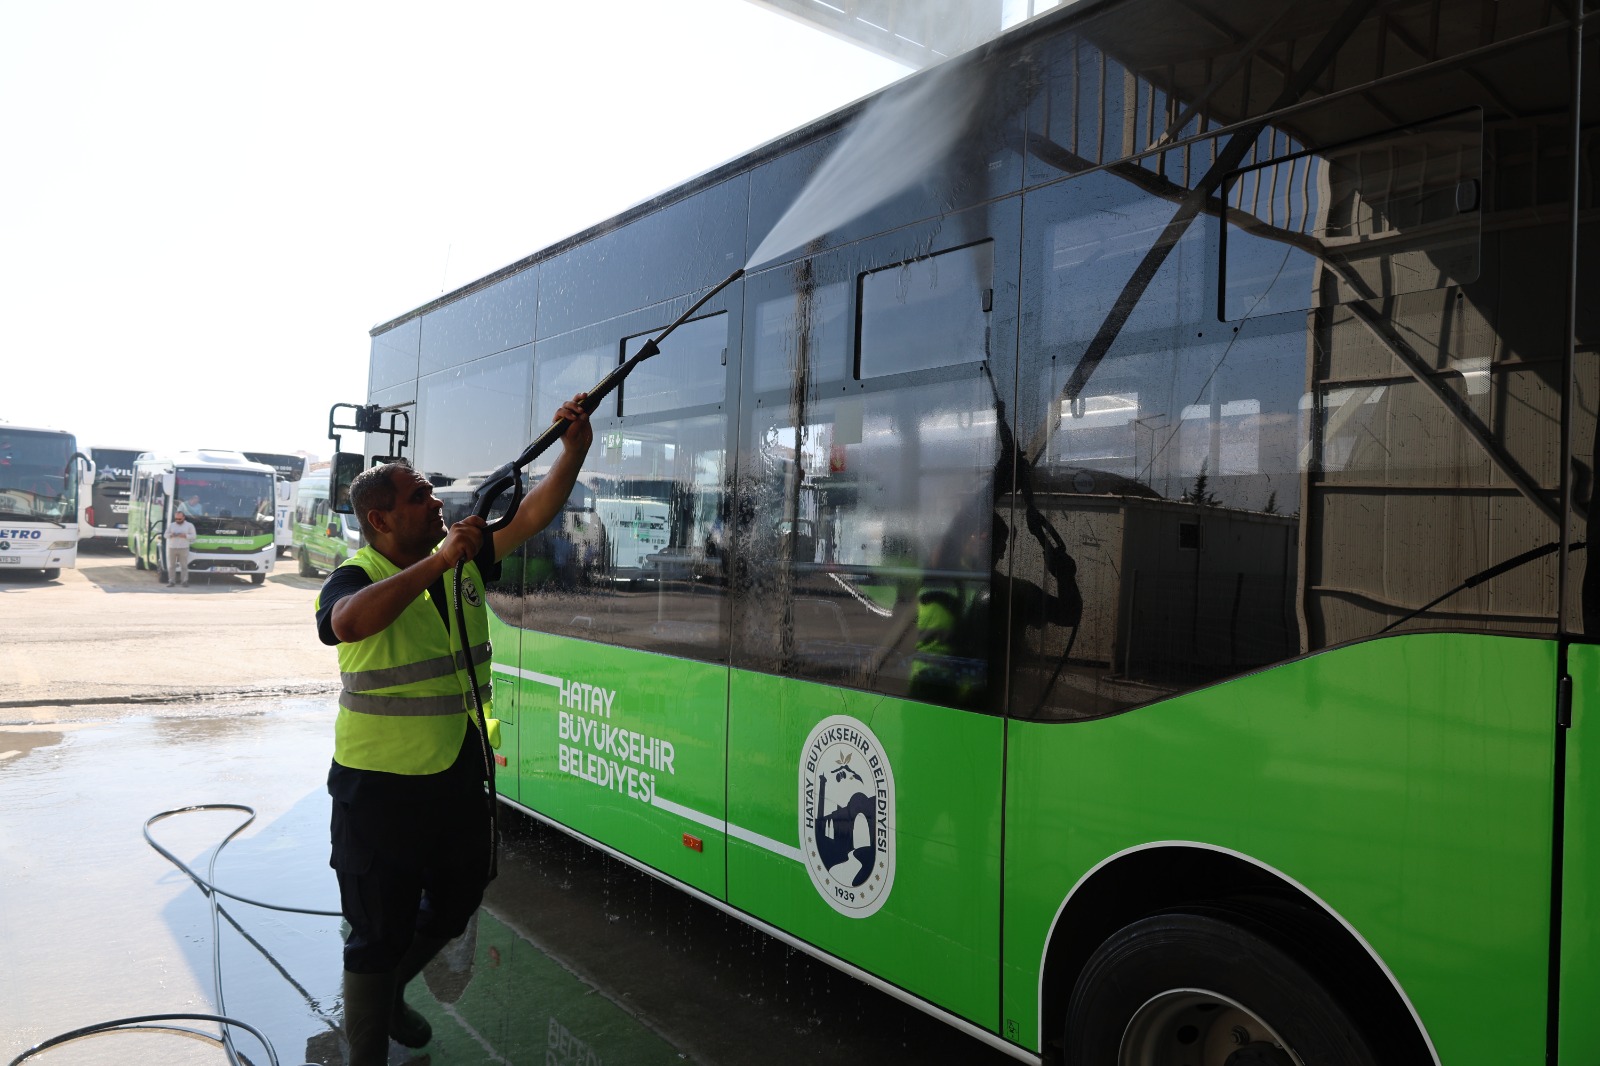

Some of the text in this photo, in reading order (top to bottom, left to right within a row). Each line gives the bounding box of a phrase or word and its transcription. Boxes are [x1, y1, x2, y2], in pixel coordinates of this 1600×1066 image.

[559, 678, 616, 718] HATAY
[558, 710, 676, 775] BÜYÜKŞEHİR
[558, 743, 657, 806] BELEDİYESİ
[805, 778, 815, 829] HATAY
[834, 886, 855, 903] 1939
